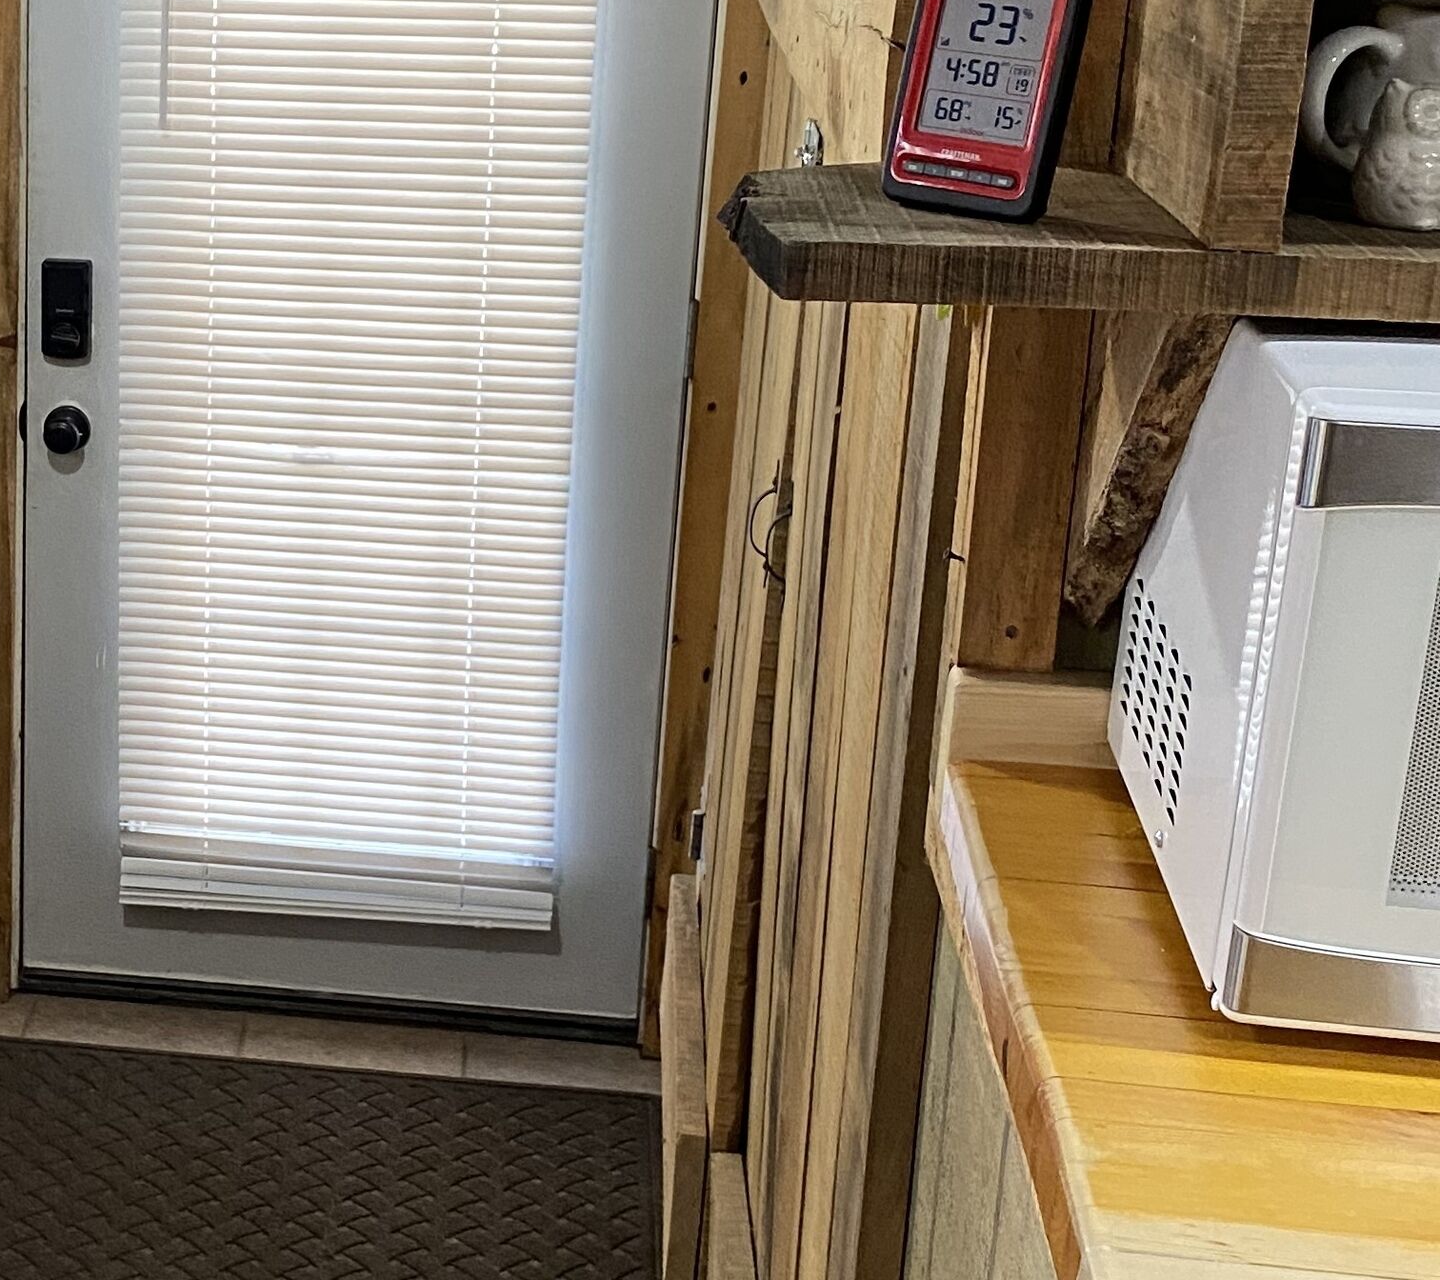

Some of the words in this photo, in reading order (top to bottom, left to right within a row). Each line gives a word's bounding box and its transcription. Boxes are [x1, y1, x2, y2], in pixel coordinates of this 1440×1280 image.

[969, 2, 1020, 45] 23
[946, 57, 1000, 87] 4:58
[934, 97, 964, 122] 68
